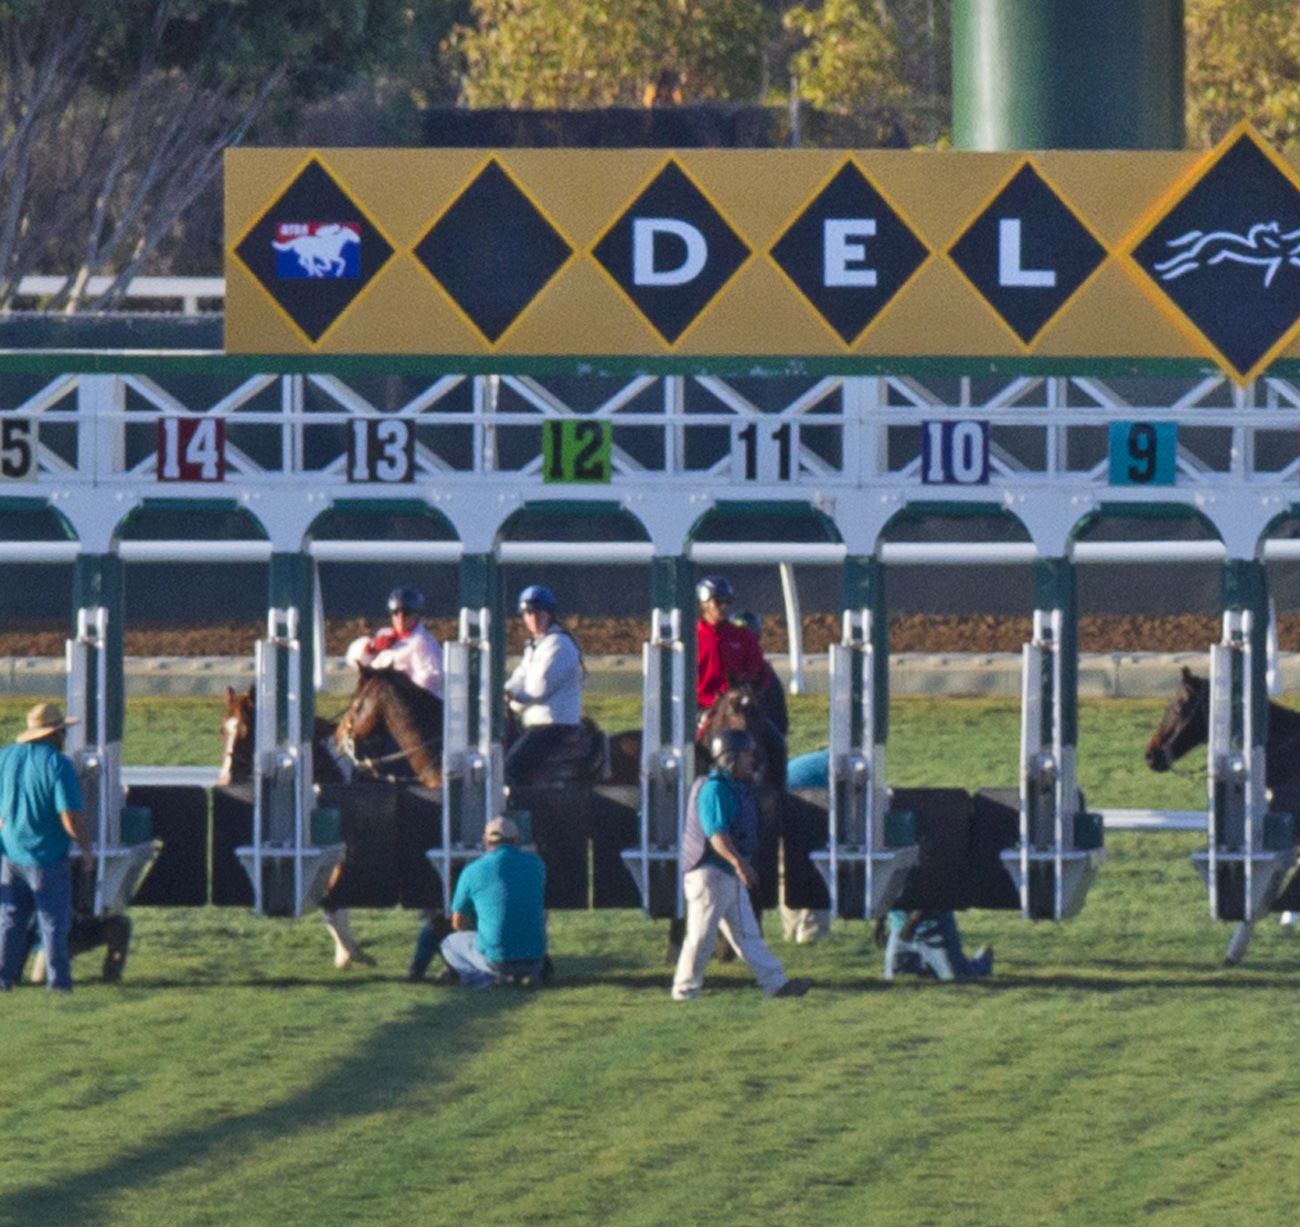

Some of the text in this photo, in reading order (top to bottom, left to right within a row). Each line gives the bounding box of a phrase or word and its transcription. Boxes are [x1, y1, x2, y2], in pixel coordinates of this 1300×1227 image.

[633, 218, 1057, 287] DEL
[163, 418, 218, 479] 14
[352, 419, 409, 480] 13
[549, 420, 605, 480] 12
[736, 422, 794, 480] 11
[929, 421, 985, 481] 10
[1128, 422, 1158, 482] 9
